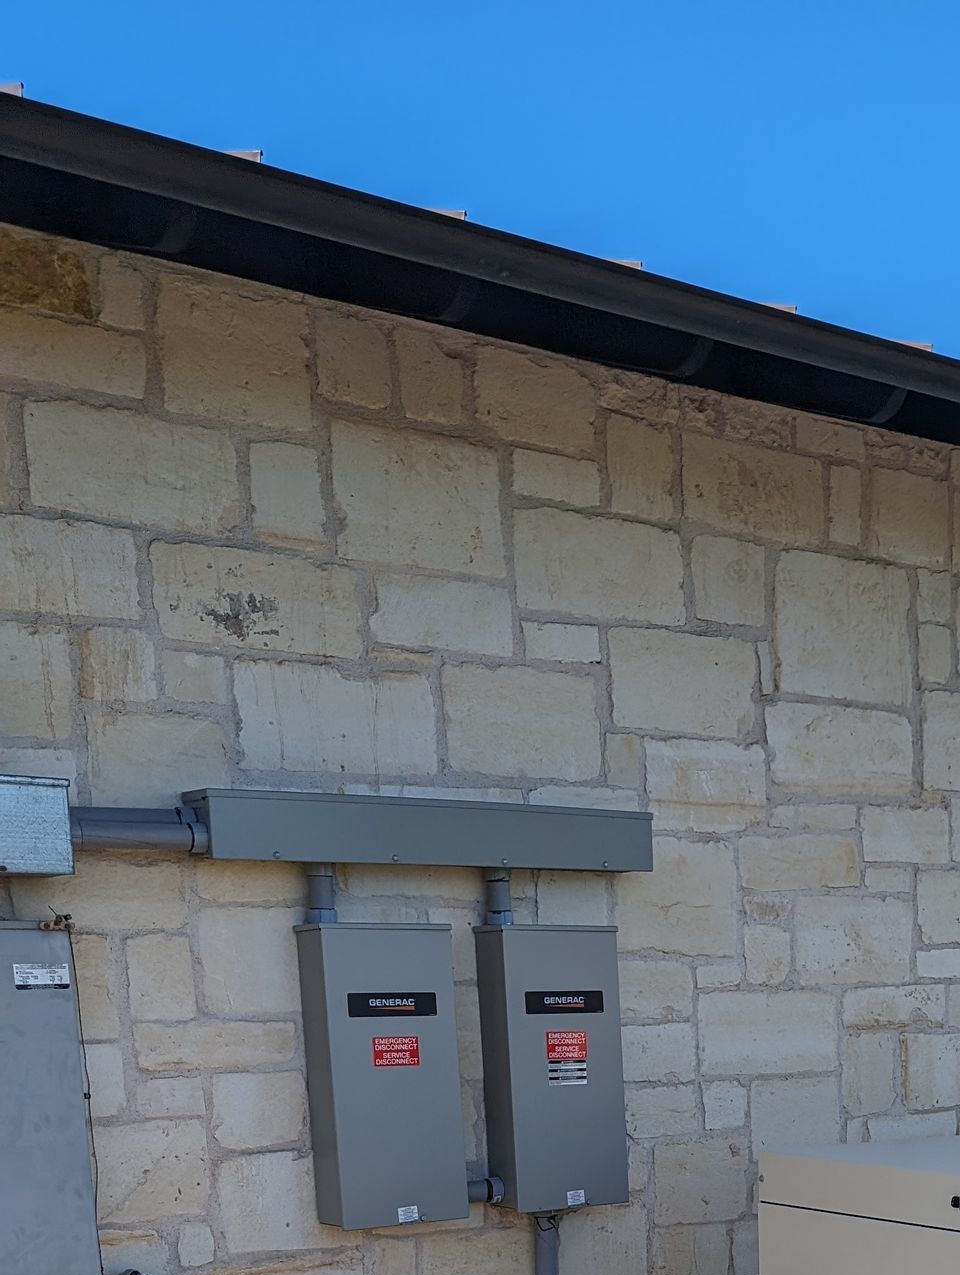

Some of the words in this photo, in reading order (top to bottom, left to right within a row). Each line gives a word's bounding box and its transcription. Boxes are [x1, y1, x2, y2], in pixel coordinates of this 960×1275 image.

[368, 998, 415, 1007] GENERAC
[543, 996, 585, 1005] GENERAC
[375, 1037, 417, 1045] EMERGENCY
[375, 1043, 418, 1051] DISCONNECT
[382, 1051, 411, 1059] SERVICE
[375, 1057, 418, 1066] DISCONNECT
